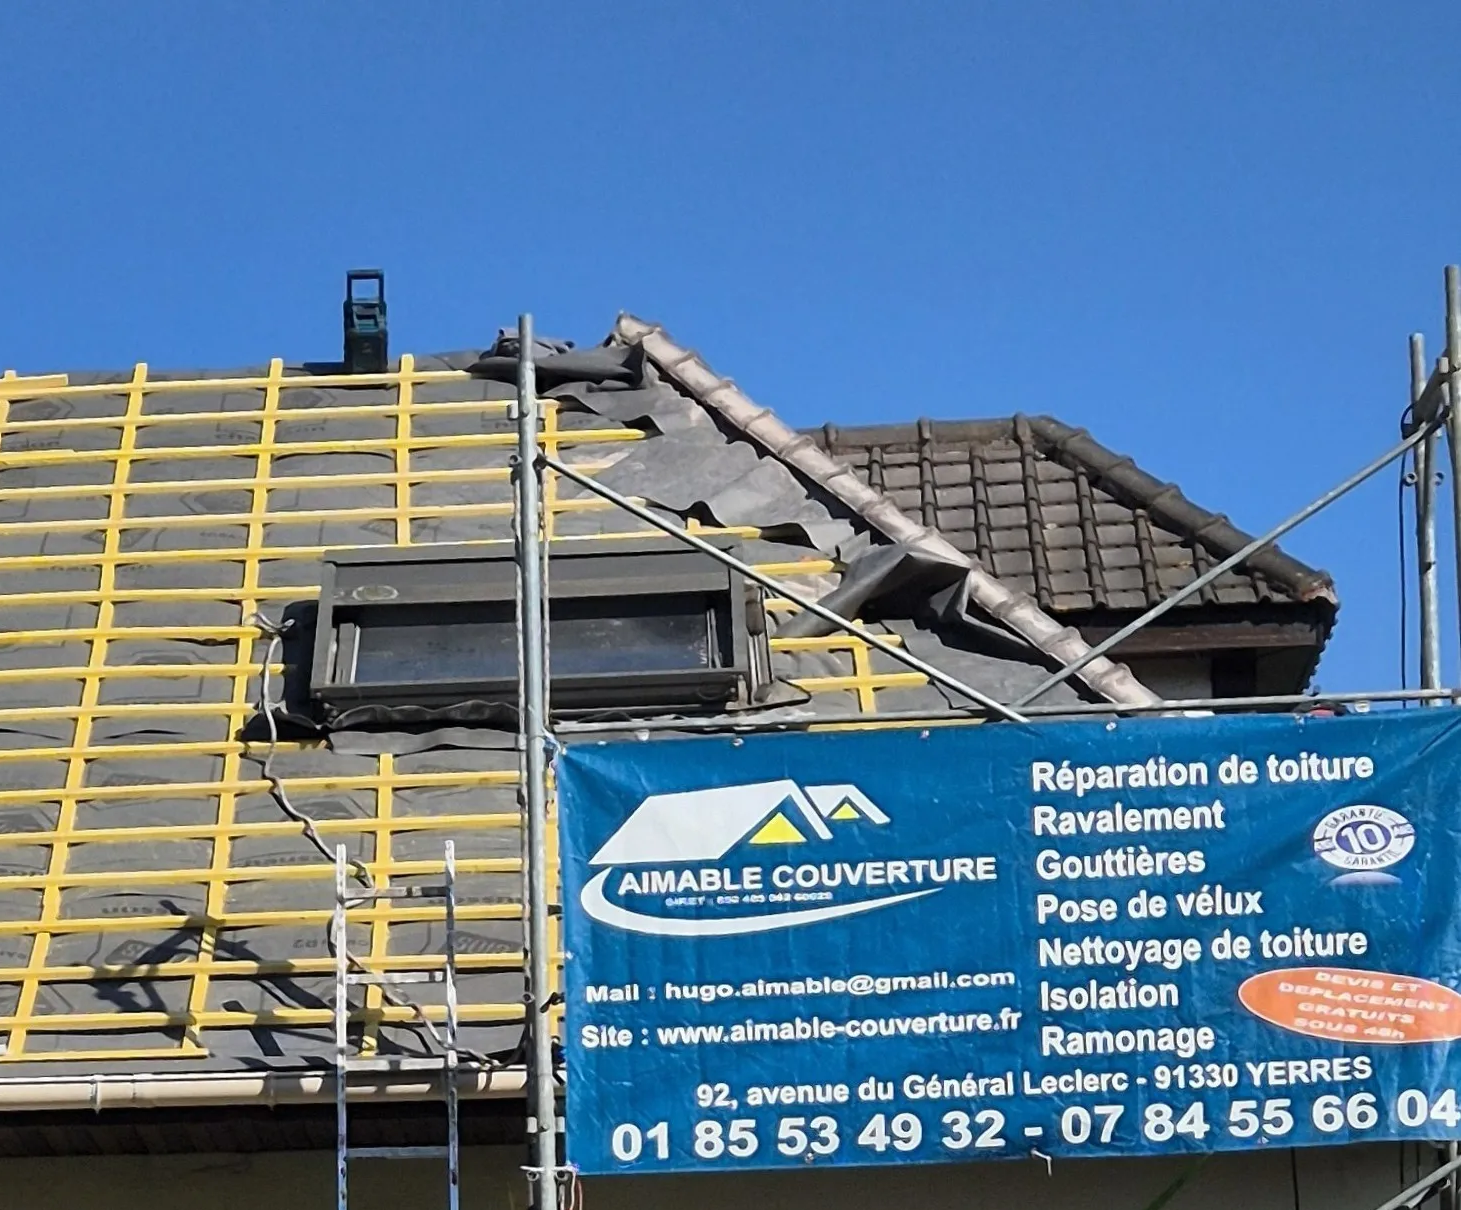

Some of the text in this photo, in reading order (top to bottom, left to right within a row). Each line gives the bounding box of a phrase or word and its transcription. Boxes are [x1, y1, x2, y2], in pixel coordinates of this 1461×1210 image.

[1032, 751, 1374, 797] Réparation de toiture
[1033, 800, 1225, 836] Ravalement
[1341, 822, 1387, 854] 10
[617, 857, 997, 896] AIMABLE COUVERTURE
[1036, 845, 1206, 880] Gouttières
[1037, 884, 1263, 924] Pose de vélux
[1039, 927, 1368, 971] Nettoyage de toiture
[586, 983, 639, 1003] Mail
[665, 971, 1015, 1002] hugo.aimable@gmail.com
[1040, 977, 1179, 1011] Isolation
[1278, 982, 1449, 1012] DEPLACEMENT
[1314, 971, 1422, 992] DEVIS ET
[581, 1024, 633, 1048] Site
[657, 1007, 1022, 1045] www.aimable-couverture.fr
[1294, 1018, 1358, 1034] SOUS
[1298, 1003, 1415, 1024] GRATUITS
[1042, 1026, 1215, 1058] Ramonage
[697, 1082, 738, 1110] 92,
[747, 1084, 849, 1106] avenue
[858, 1076, 894, 1101] du
[903, 1071, 1014, 1099] Général
[1023, 1068, 1129, 1095] Leclerc
[1154, 1063, 1238, 1089] 91330
[1246, 1056, 1372, 1087] YERRES
[612, 1088, 1461, 1161] 01 85 53 49 32 - 07 84 55 66 04
